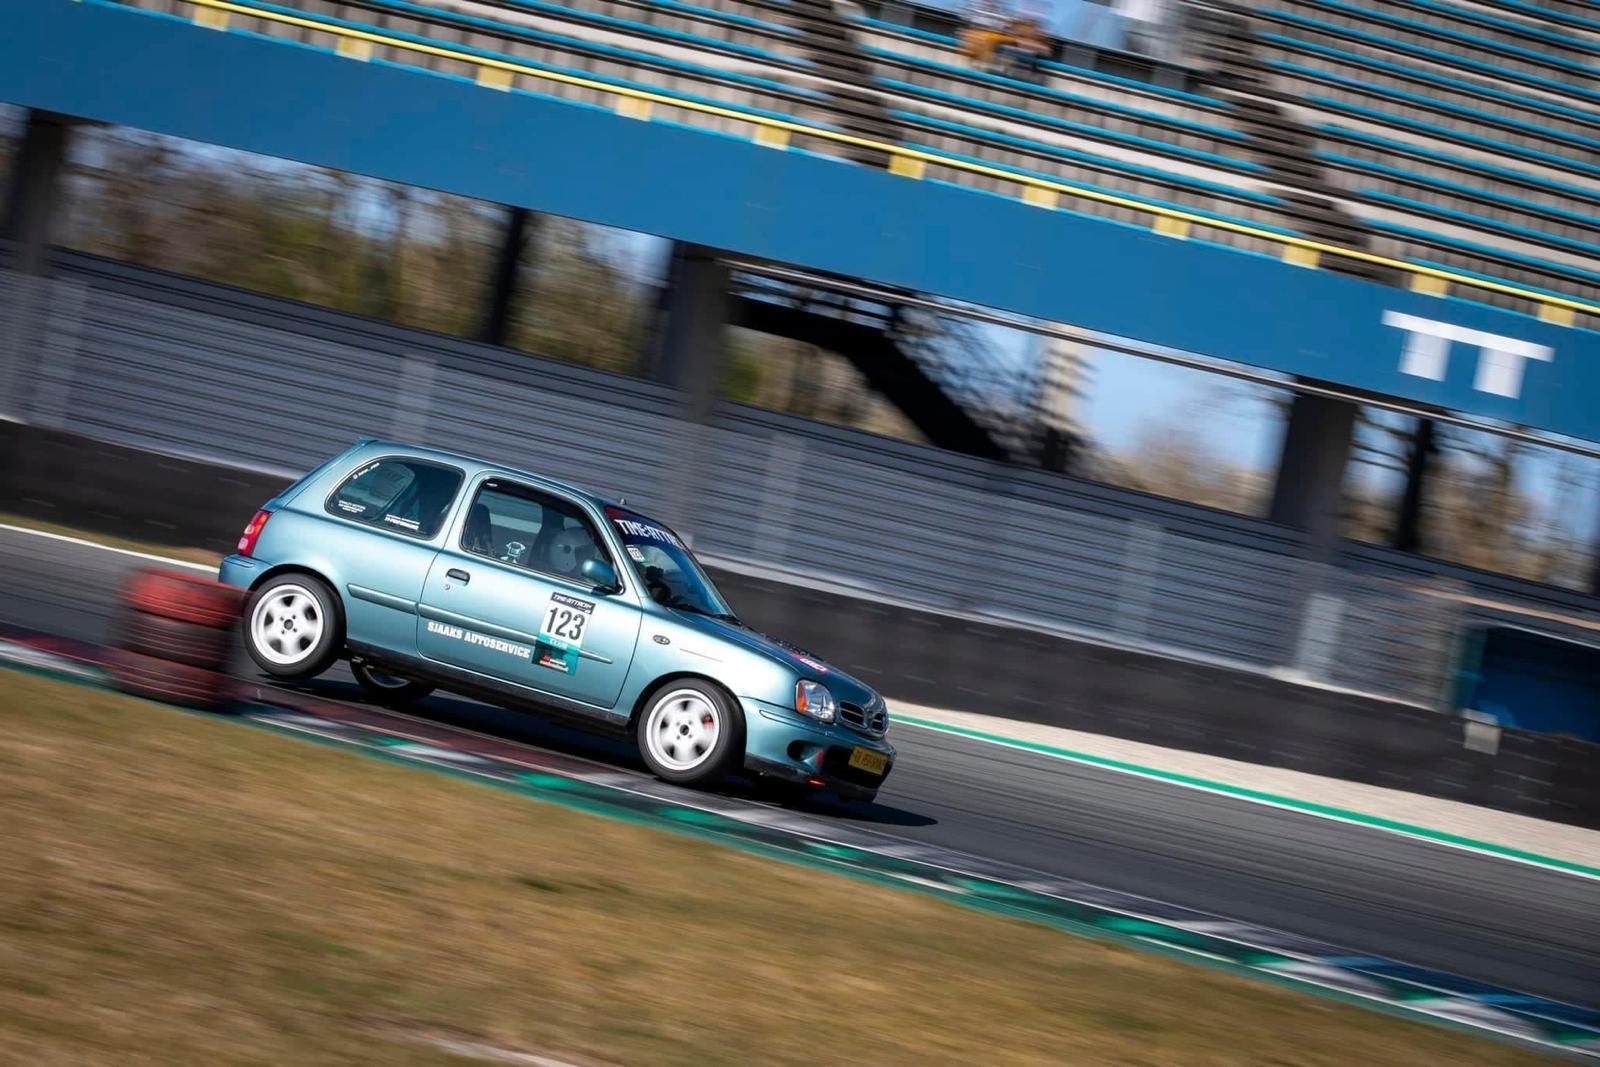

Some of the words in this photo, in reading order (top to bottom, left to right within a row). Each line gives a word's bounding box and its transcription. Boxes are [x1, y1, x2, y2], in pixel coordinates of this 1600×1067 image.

[1381, 309, 1556, 400] TT
[427, 621, 464, 640] SJAAKS
[463, 631, 531, 659] AUTOSERVICE
[546, 607, 586, 641] 123
